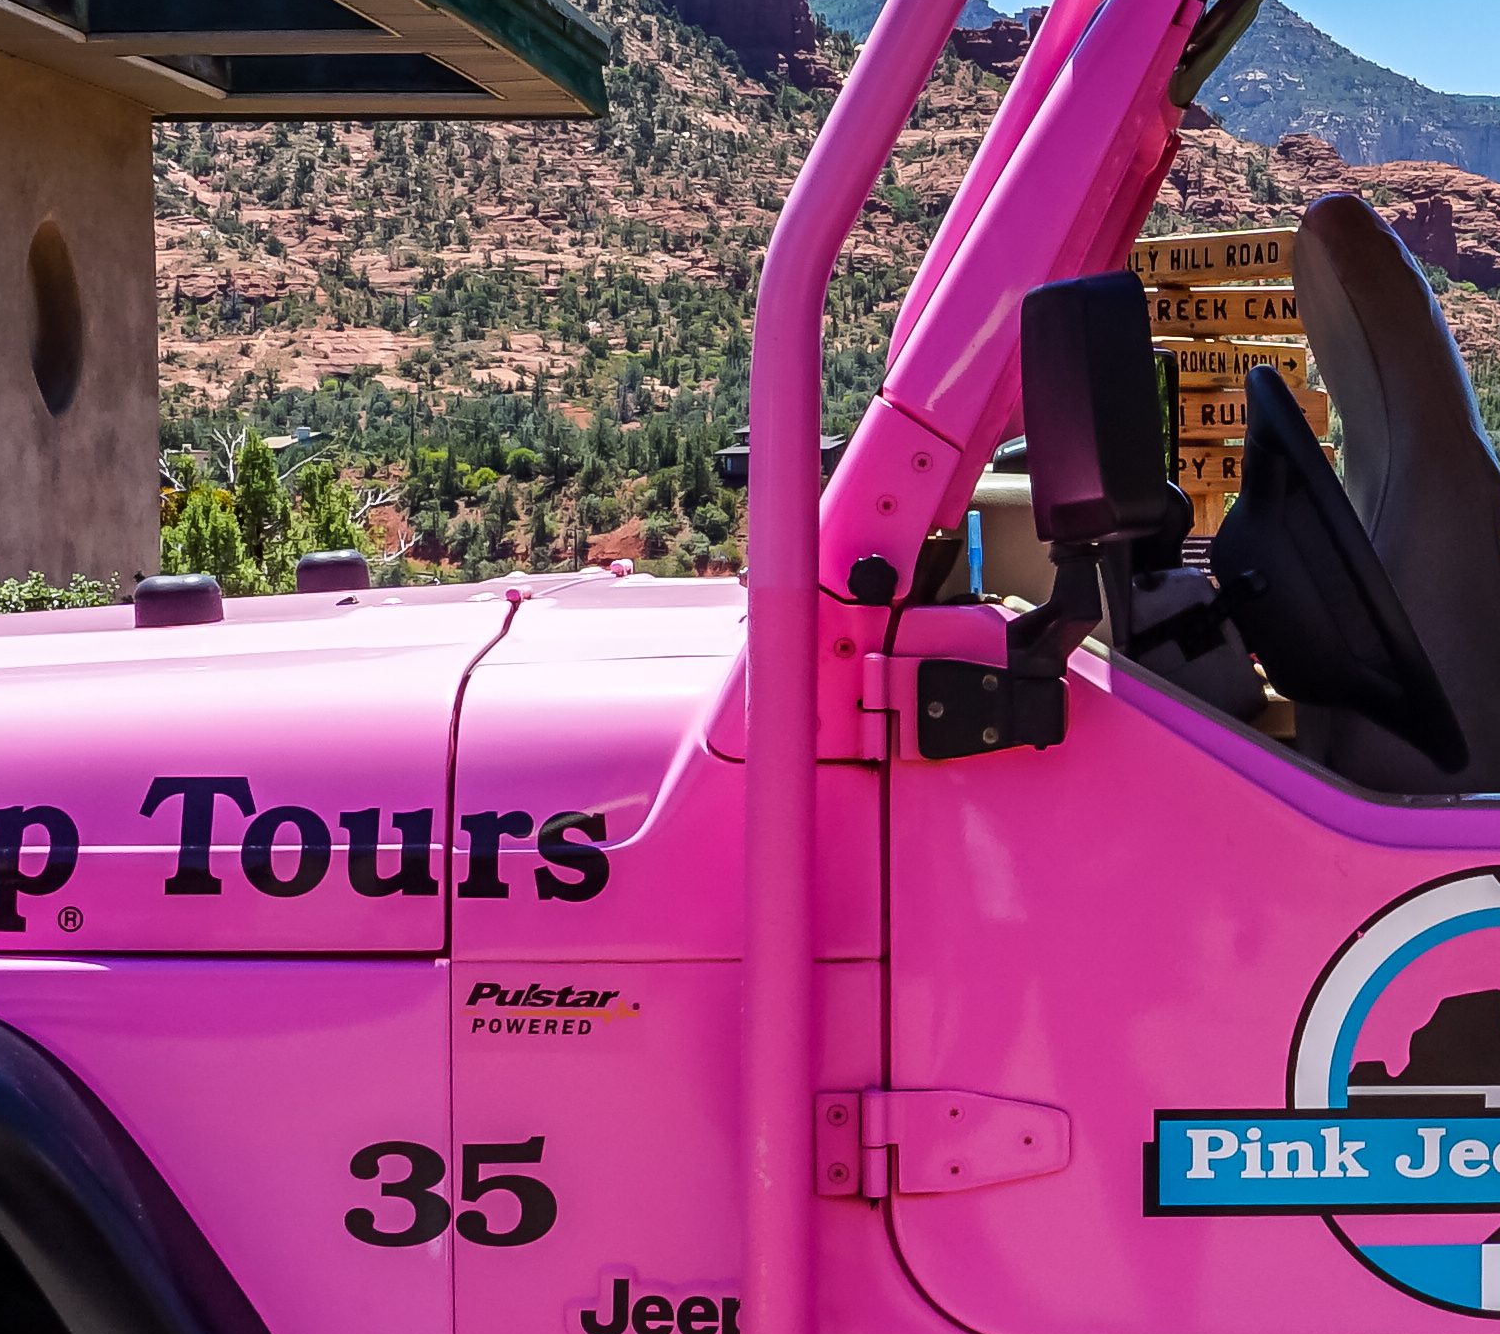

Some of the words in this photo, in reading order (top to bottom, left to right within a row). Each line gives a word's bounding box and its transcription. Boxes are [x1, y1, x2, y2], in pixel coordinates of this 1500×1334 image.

[1170, 247, 1214, 270] HILL
[1226, 242, 1279, 267] ROAD
[1245, 298, 1297, 320] CAN
[1177, 351, 1226, 373] ROKEN
[139, 776, 610, 903] Tours
[465, 982, 621, 1008] Pulstar
[471, 1017, 593, 1036] POWERED
[1186, 1125, 1369, 1181] Pink
[344, 1136, 558, 1247] 35
